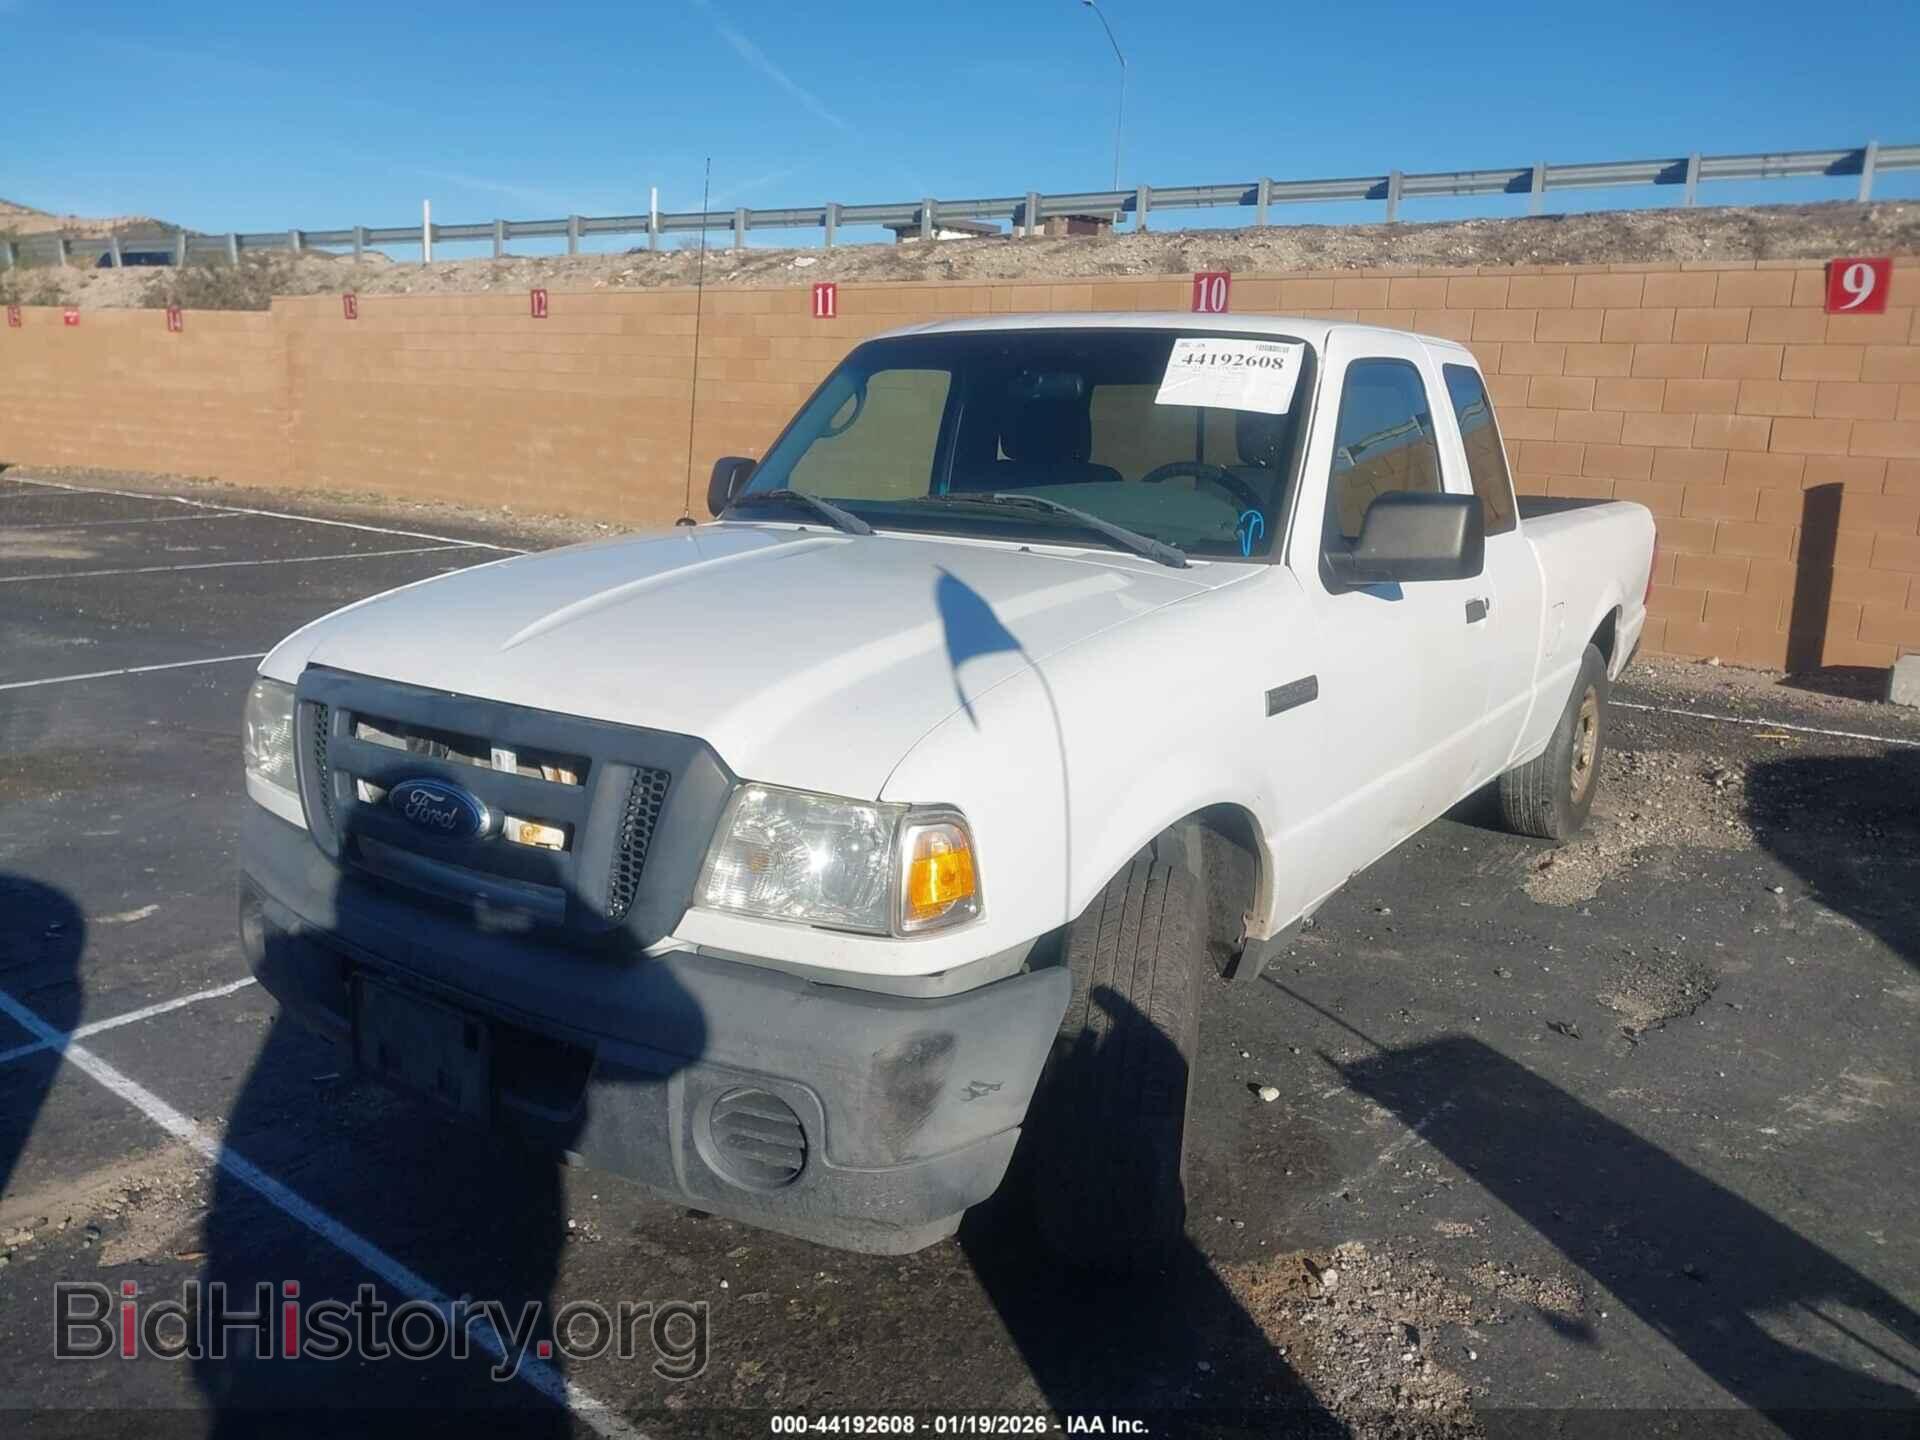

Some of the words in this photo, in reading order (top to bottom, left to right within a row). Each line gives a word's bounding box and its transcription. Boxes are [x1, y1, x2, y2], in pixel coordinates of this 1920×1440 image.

[815, 287, 834, 316] 11
[1197, 276, 1226, 312] 10
[1840, 263, 1875, 310] 9
[1182, 352, 1285, 370] 44192608
[404, 788, 459, 830] Ford
